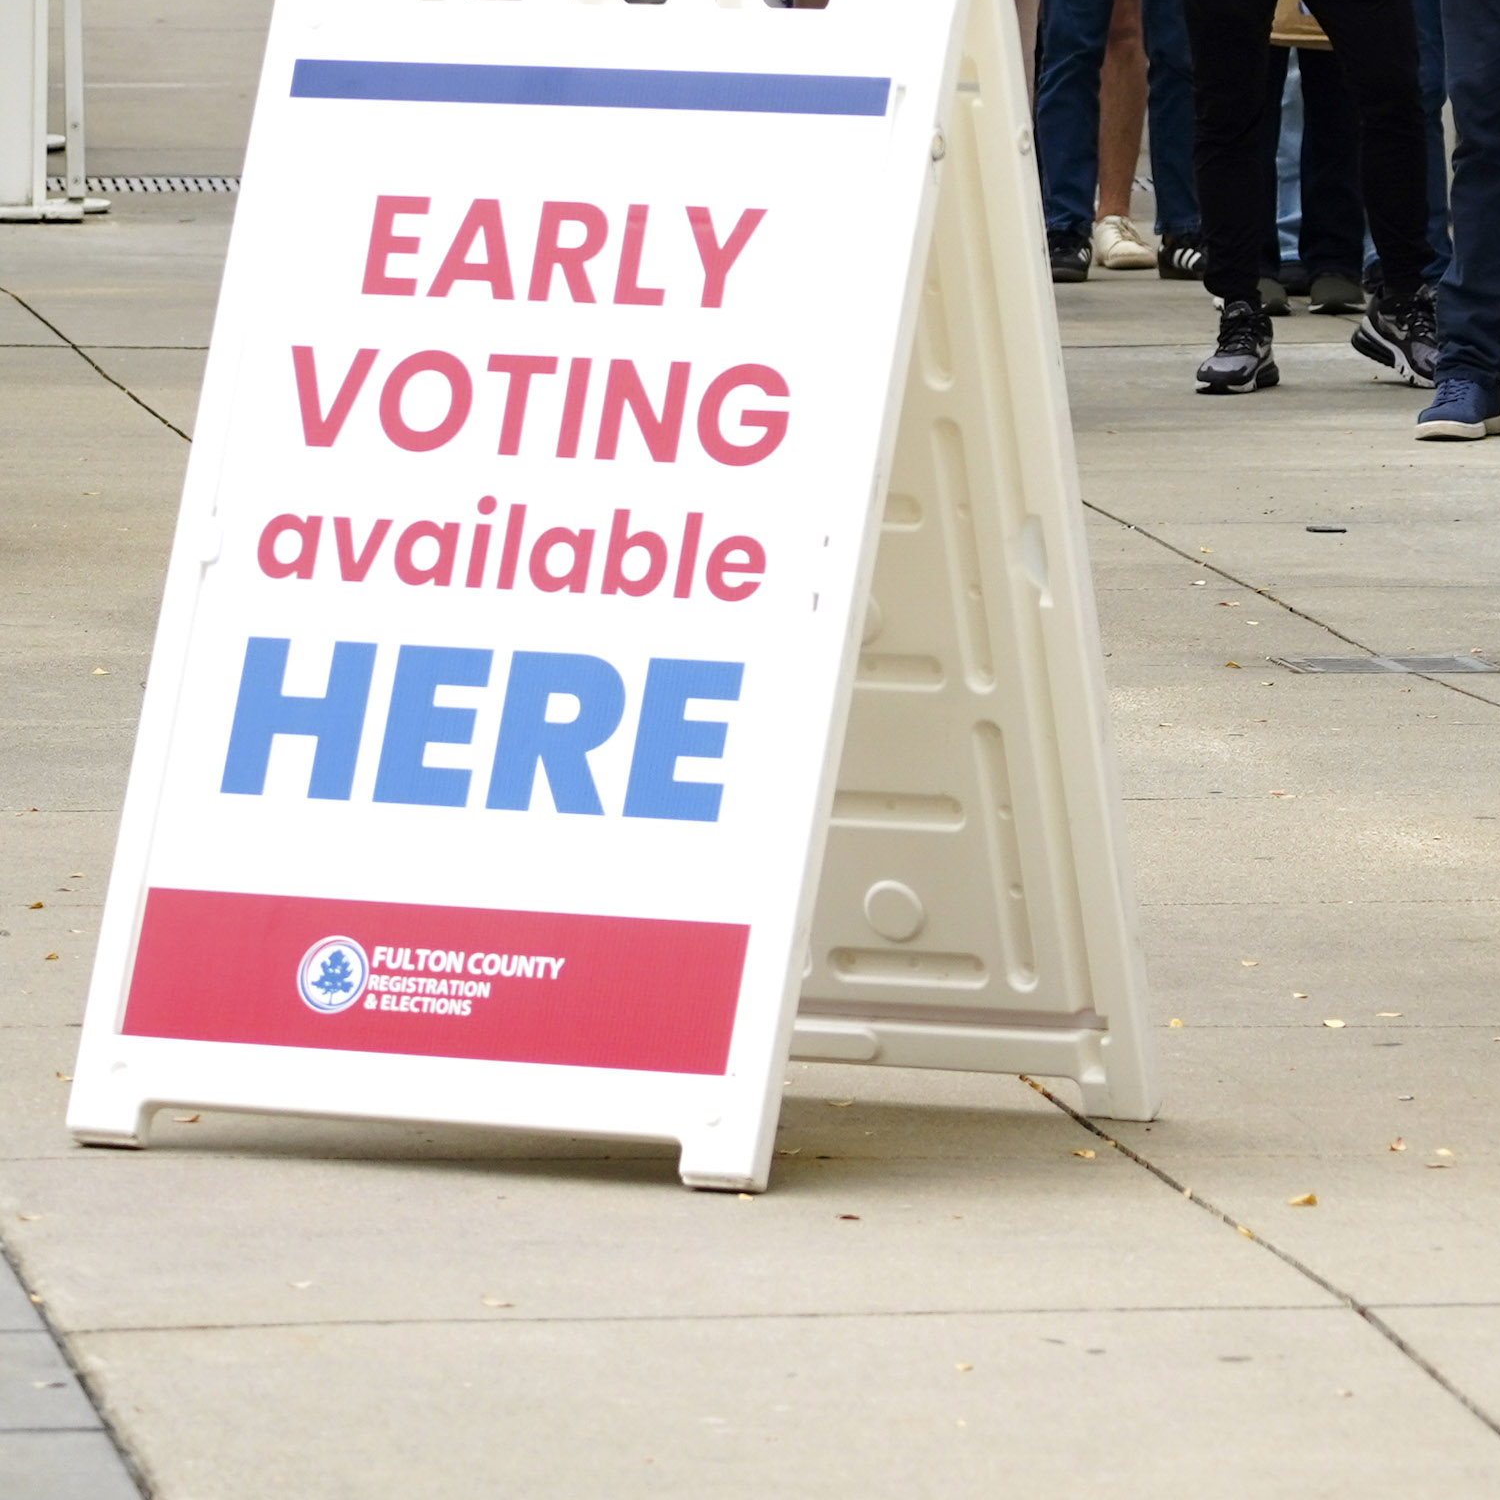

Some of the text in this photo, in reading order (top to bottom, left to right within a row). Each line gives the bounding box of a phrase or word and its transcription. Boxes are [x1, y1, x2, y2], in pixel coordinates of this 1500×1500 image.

[361, 195, 768, 309] EARLY
[290, 344, 790, 468] VOTING
[257, 496, 768, 602] available
[219, 636, 746, 823] HERE
[362, 993, 472, 1017] & ELECTIONS
[366, 973, 491, 999] REGISTRATION
[371, 945, 566, 980] FULTON COUNTY
